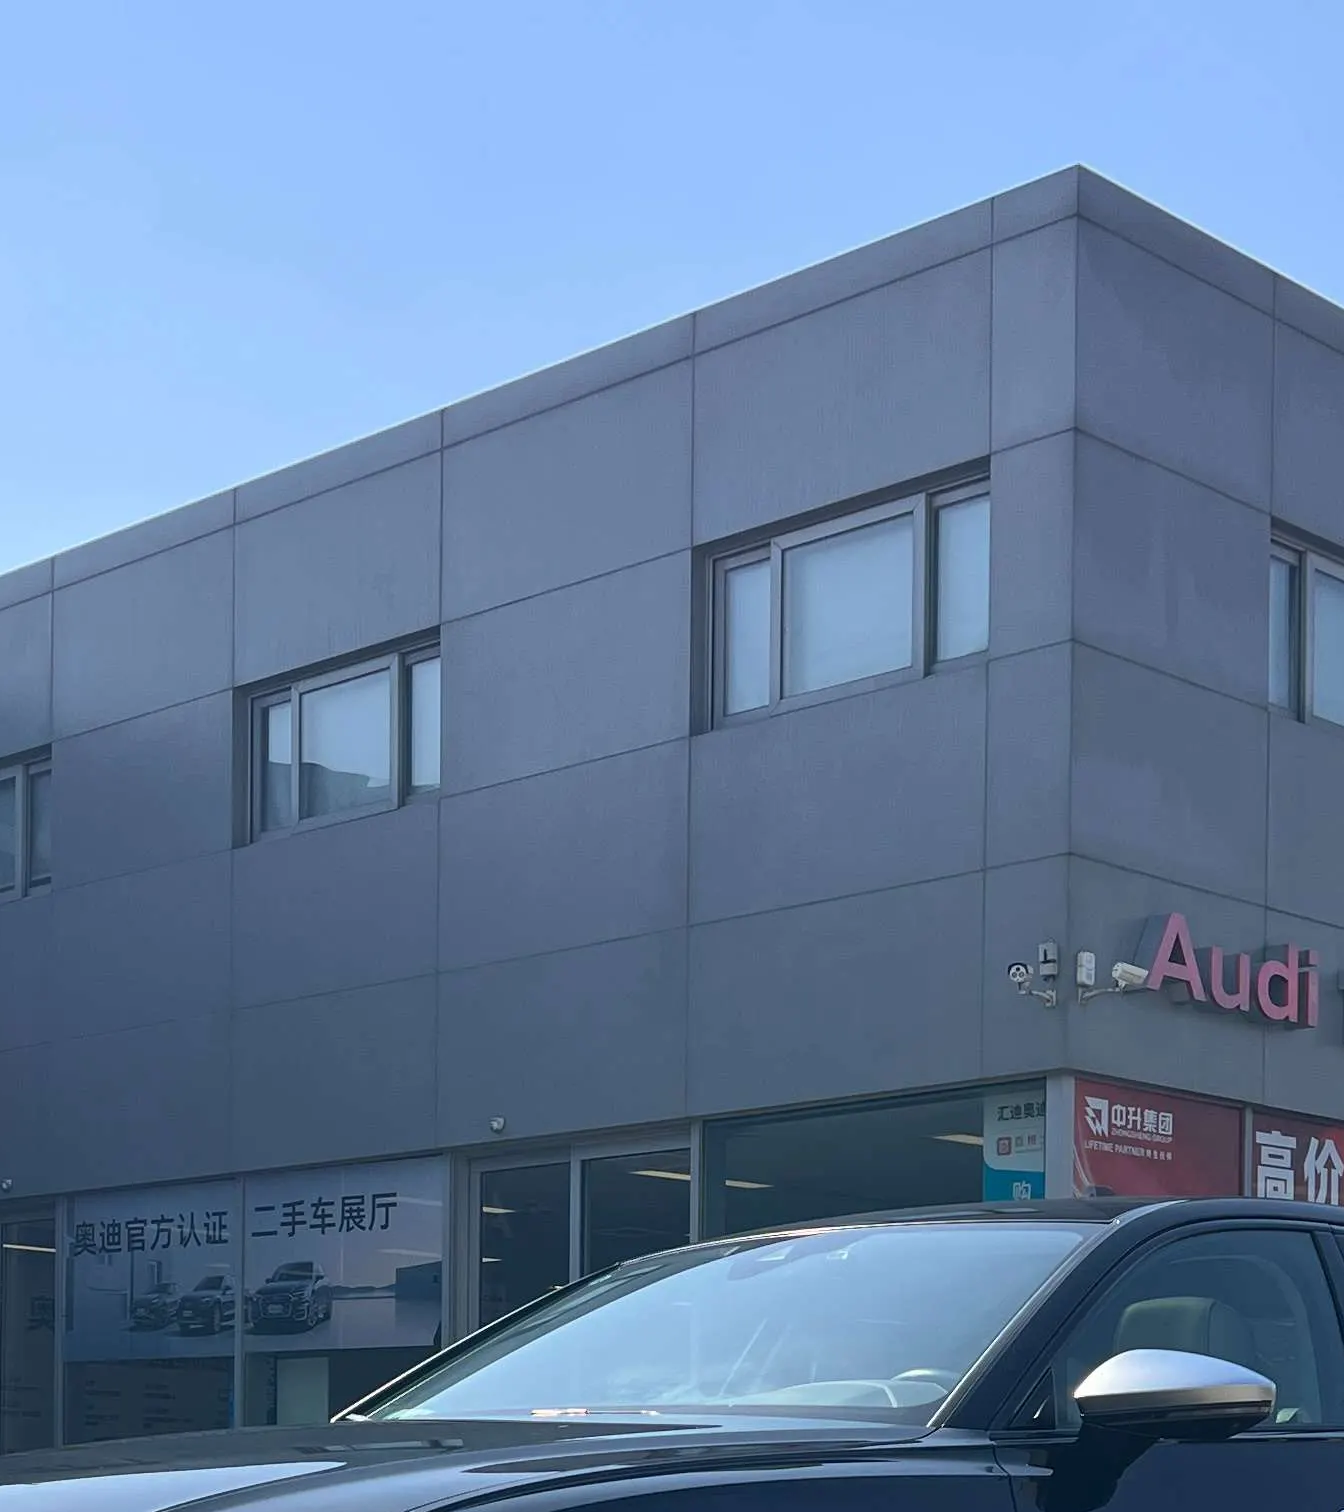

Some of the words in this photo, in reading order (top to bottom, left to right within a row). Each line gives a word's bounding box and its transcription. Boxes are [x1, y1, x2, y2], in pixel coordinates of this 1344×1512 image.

[1146, 912, 1320, 1028] Audi
[1111, 1104, 1173, 1135] 中升集团
[73, 1211, 229, 1257] 奥迪官方认证
[251, 1192, 398, 1237] 二手车展厅
